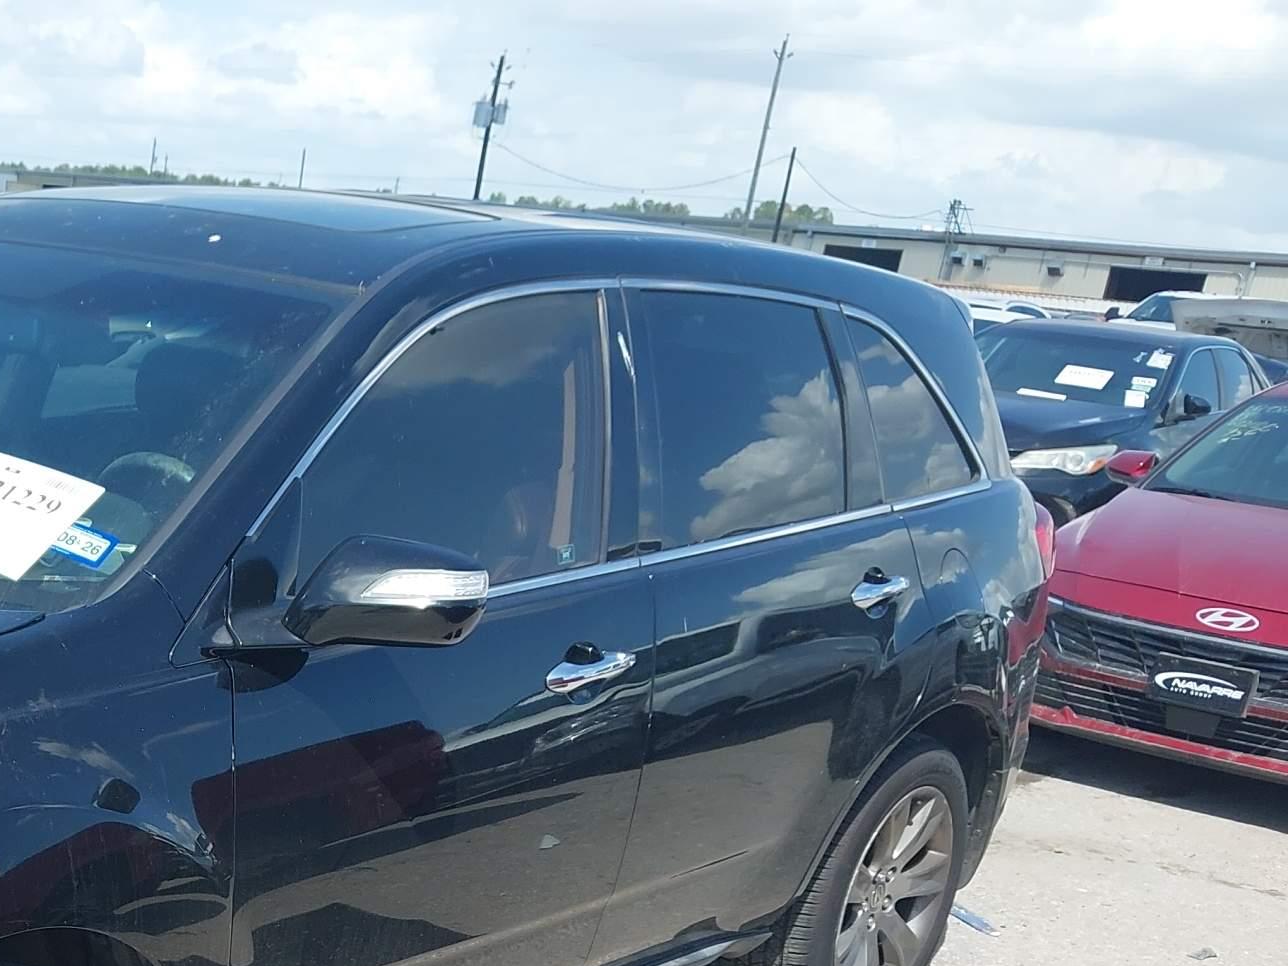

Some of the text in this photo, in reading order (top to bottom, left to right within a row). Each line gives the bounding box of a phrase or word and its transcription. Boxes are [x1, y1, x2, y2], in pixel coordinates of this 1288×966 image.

[1170, 686, 1213, 699] AUTO GROUP
[1171, 678, 1246, 700] NAVARRE
